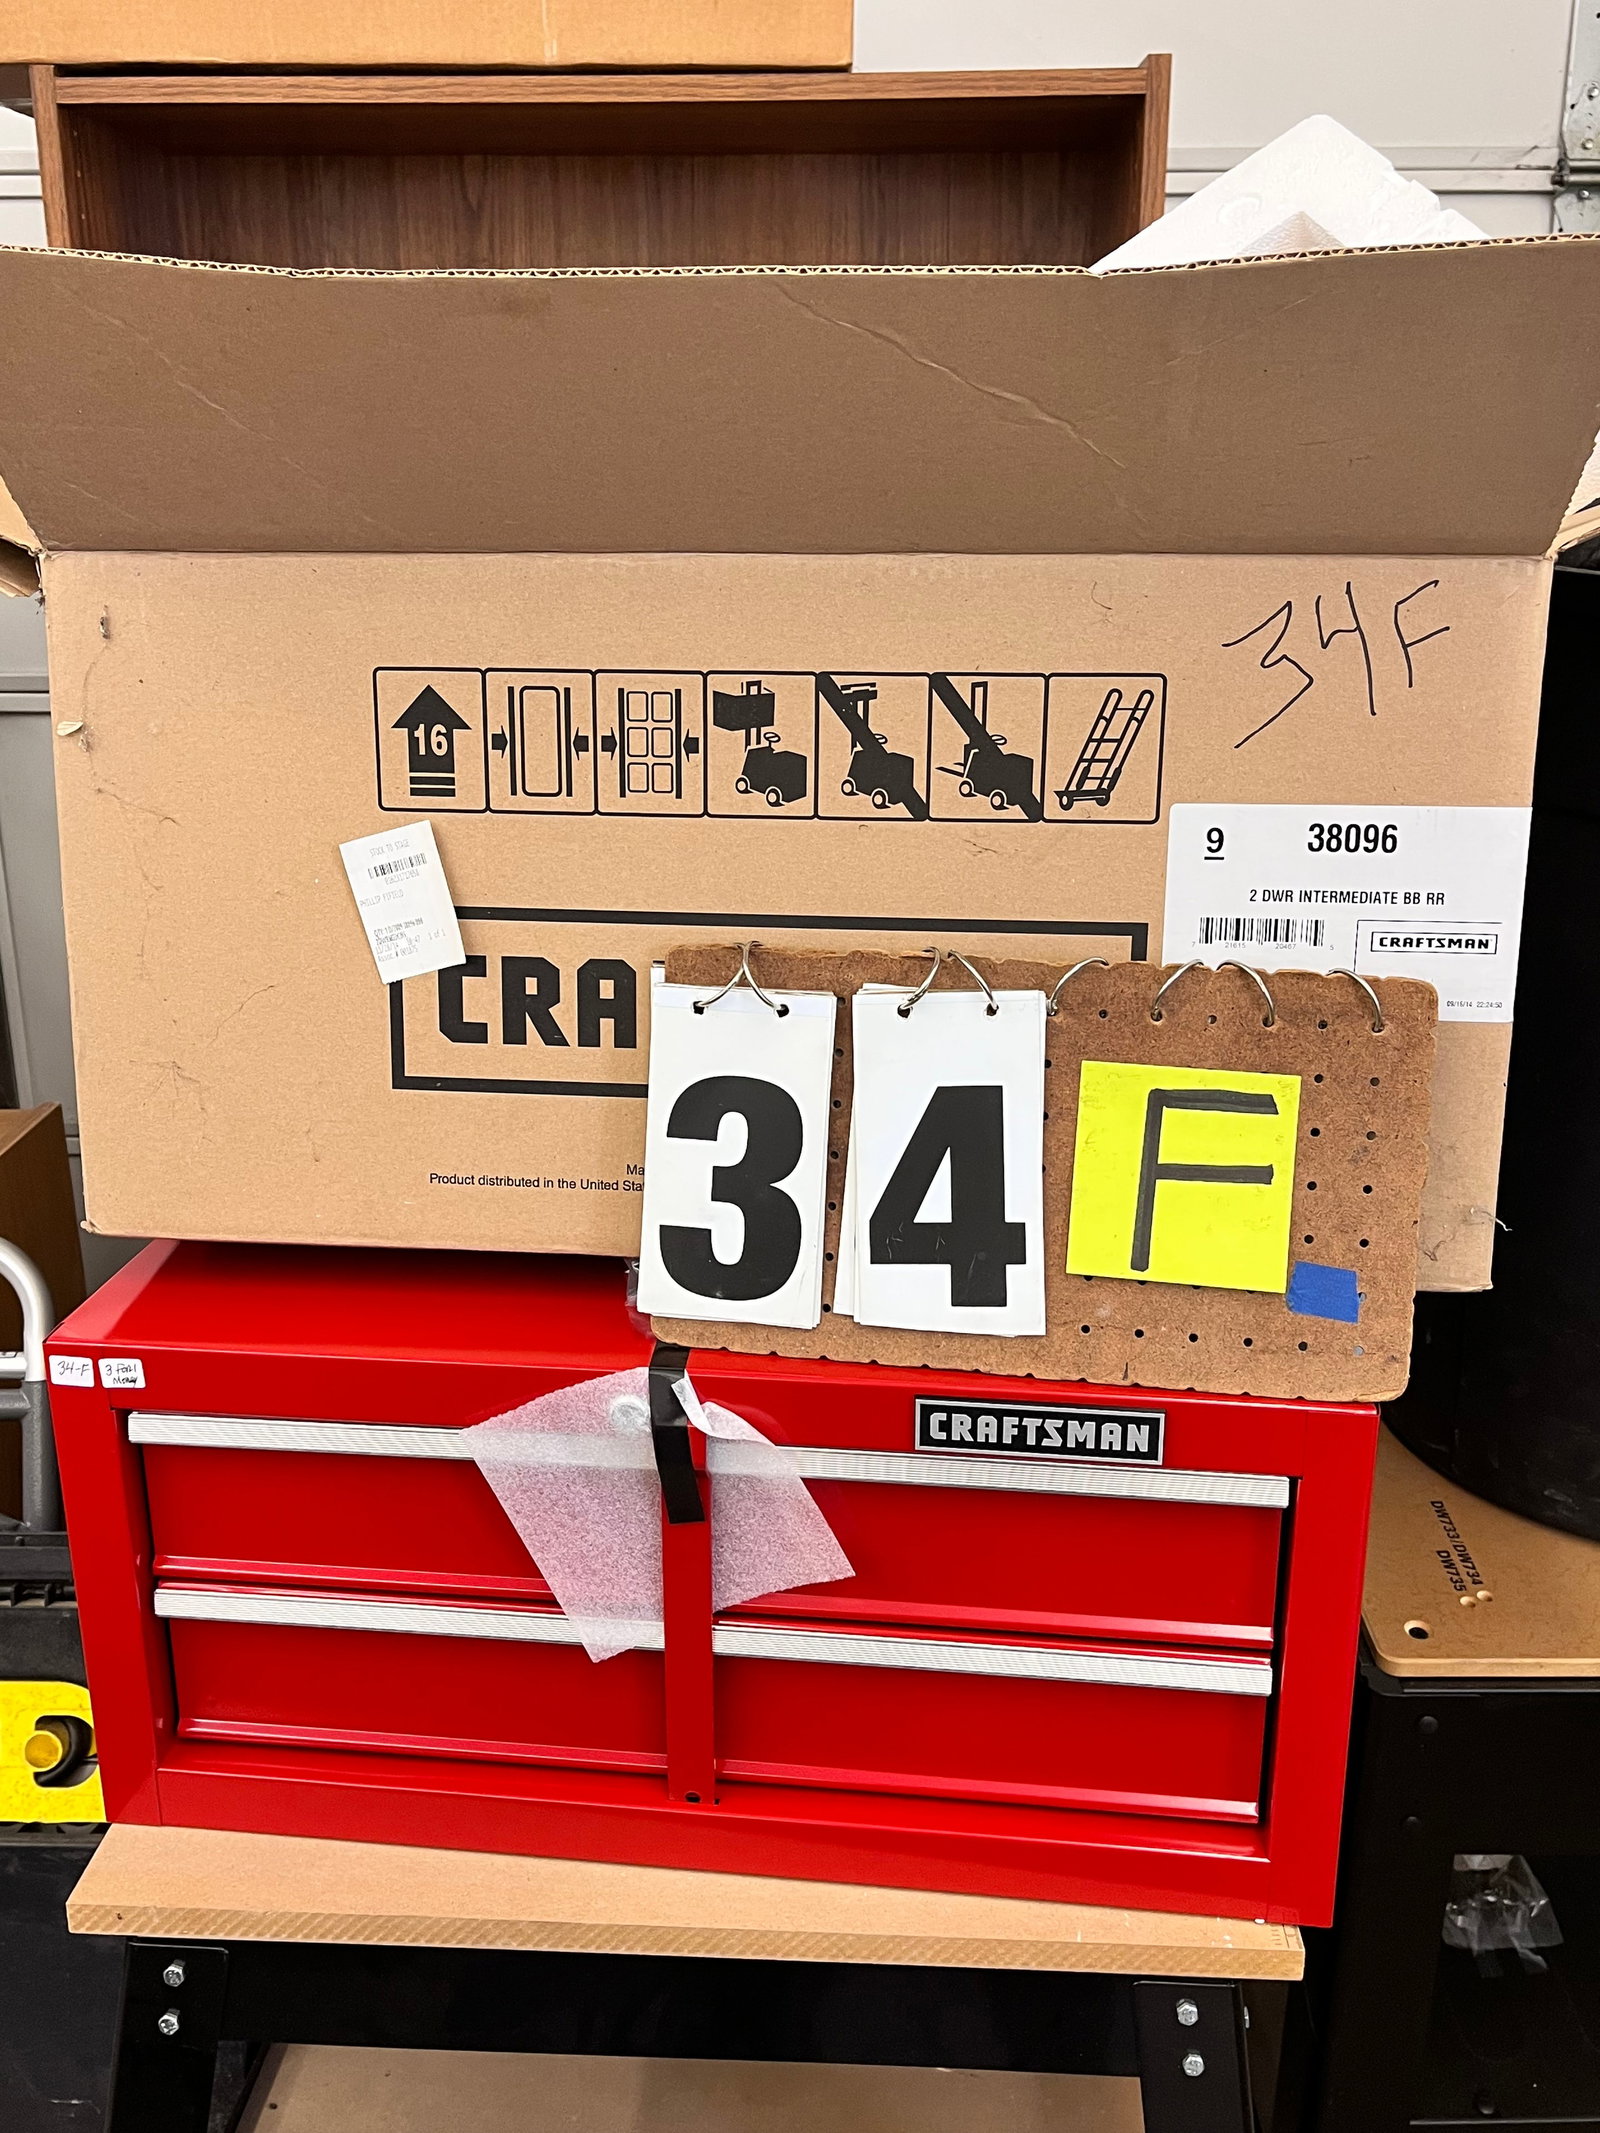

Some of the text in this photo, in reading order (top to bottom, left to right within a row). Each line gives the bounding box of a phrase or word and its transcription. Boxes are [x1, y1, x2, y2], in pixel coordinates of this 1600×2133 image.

[1222, 580, 1450, 749] 34F
[413, 723, 449, 756] 16
[1206, 823, 1399, 854] 9 38096
[1249, 889, 1446, 906] 2 DWR INTERMEDIATE BB RR
[1379, 937, 1490, 950] CRAFTSMAN
[429, 1173, 645, 1192] Product distributed in the United Sta
[1130, 1087, 1278, 1273] F
[929, 1412, 1150, 1453] CRAFTSMAN
[1430, 1500, 1484, 1586] DW733/DW734
[1436, 1549, 1468, 1592] DW735
